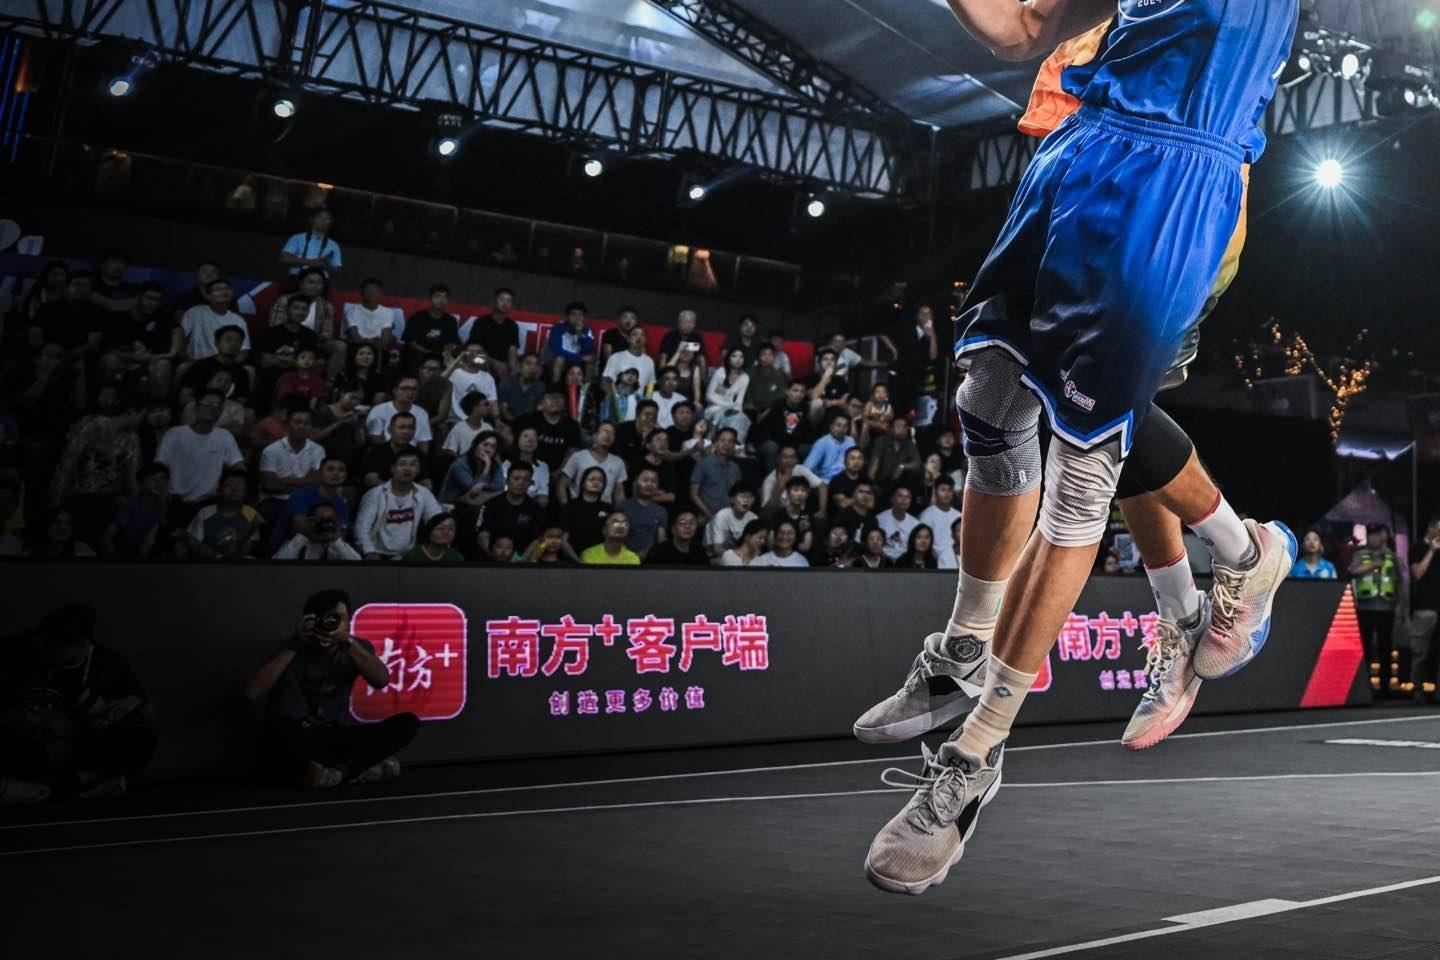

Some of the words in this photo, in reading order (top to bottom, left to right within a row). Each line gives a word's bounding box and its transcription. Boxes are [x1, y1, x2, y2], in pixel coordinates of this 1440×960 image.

[485, 613, 770, 679] 南方+客户端
[547, 685, 706, 716] 创造更多价值
